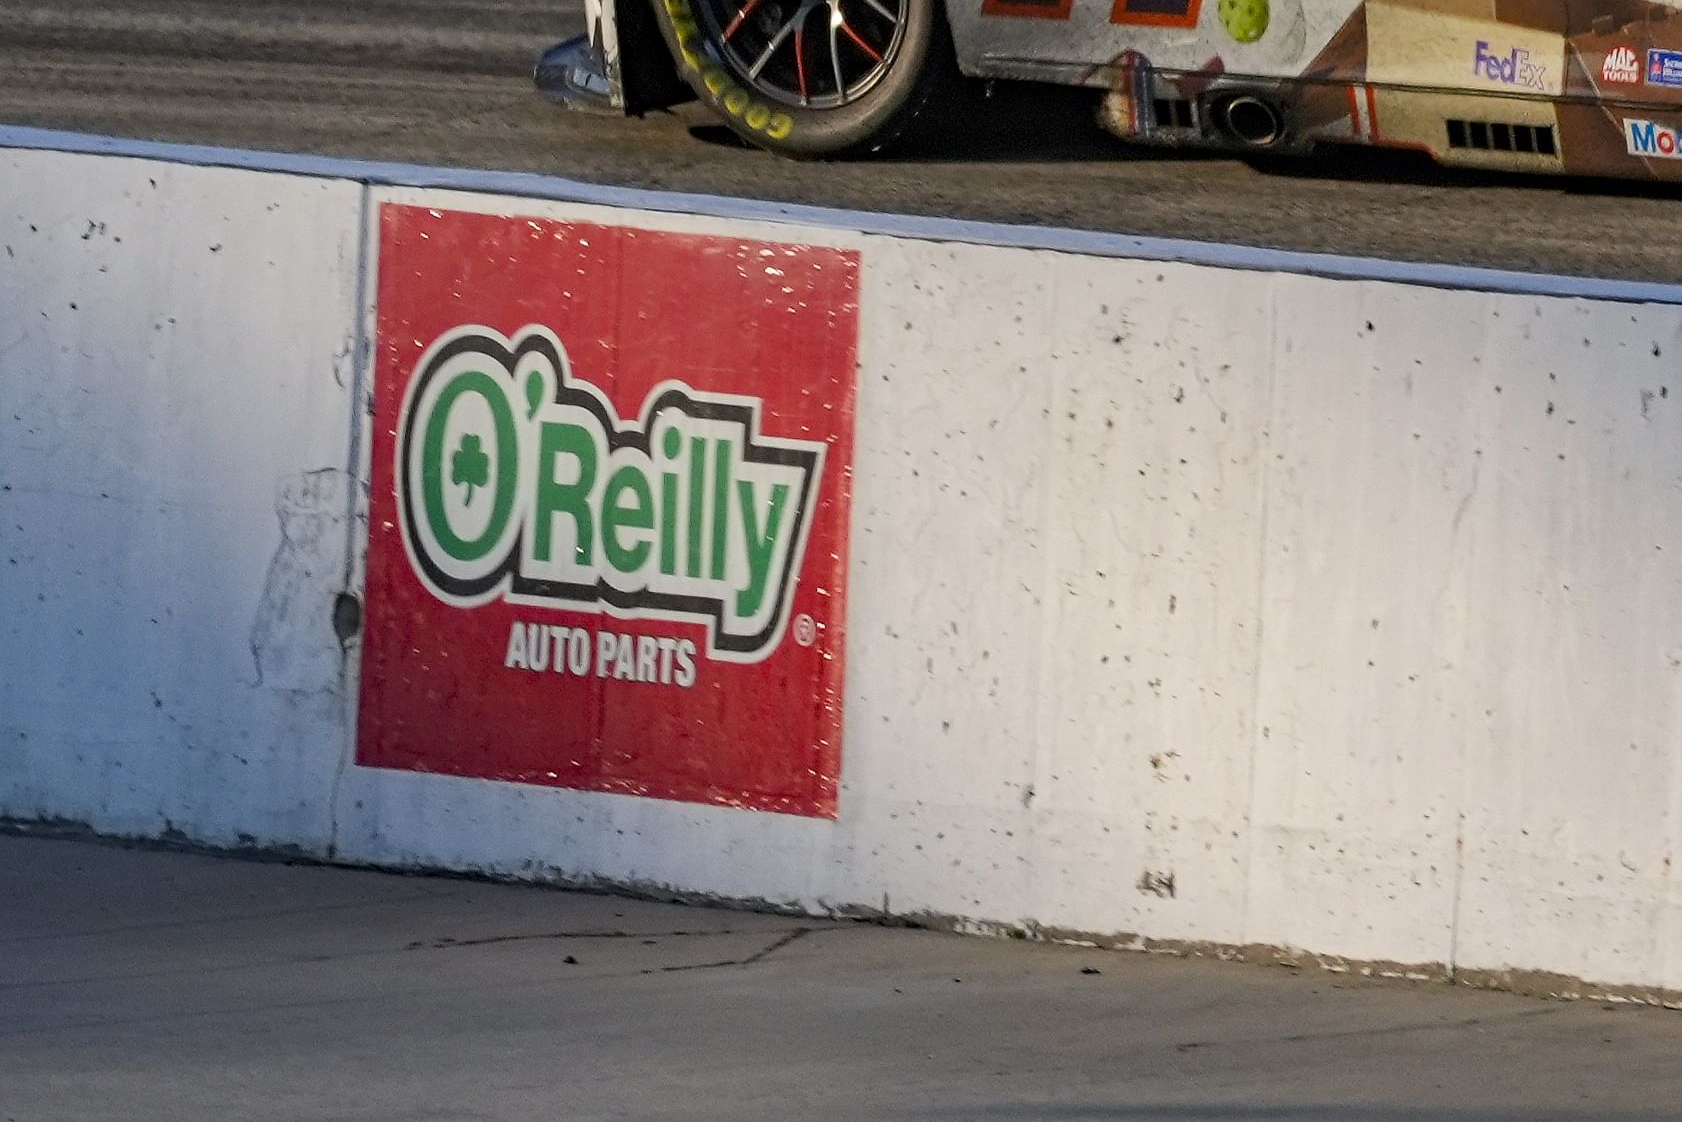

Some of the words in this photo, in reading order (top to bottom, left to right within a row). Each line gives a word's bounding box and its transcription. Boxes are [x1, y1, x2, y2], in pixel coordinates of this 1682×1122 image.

[1475, 40, 1546, 91] FedEx
[1603, 46, 1638, 70] MAC
[421, 368, 790, 619] O'Reilly
[505, 621, 591, 677] AUTO
[596, 630, 698, 688] PARTS
